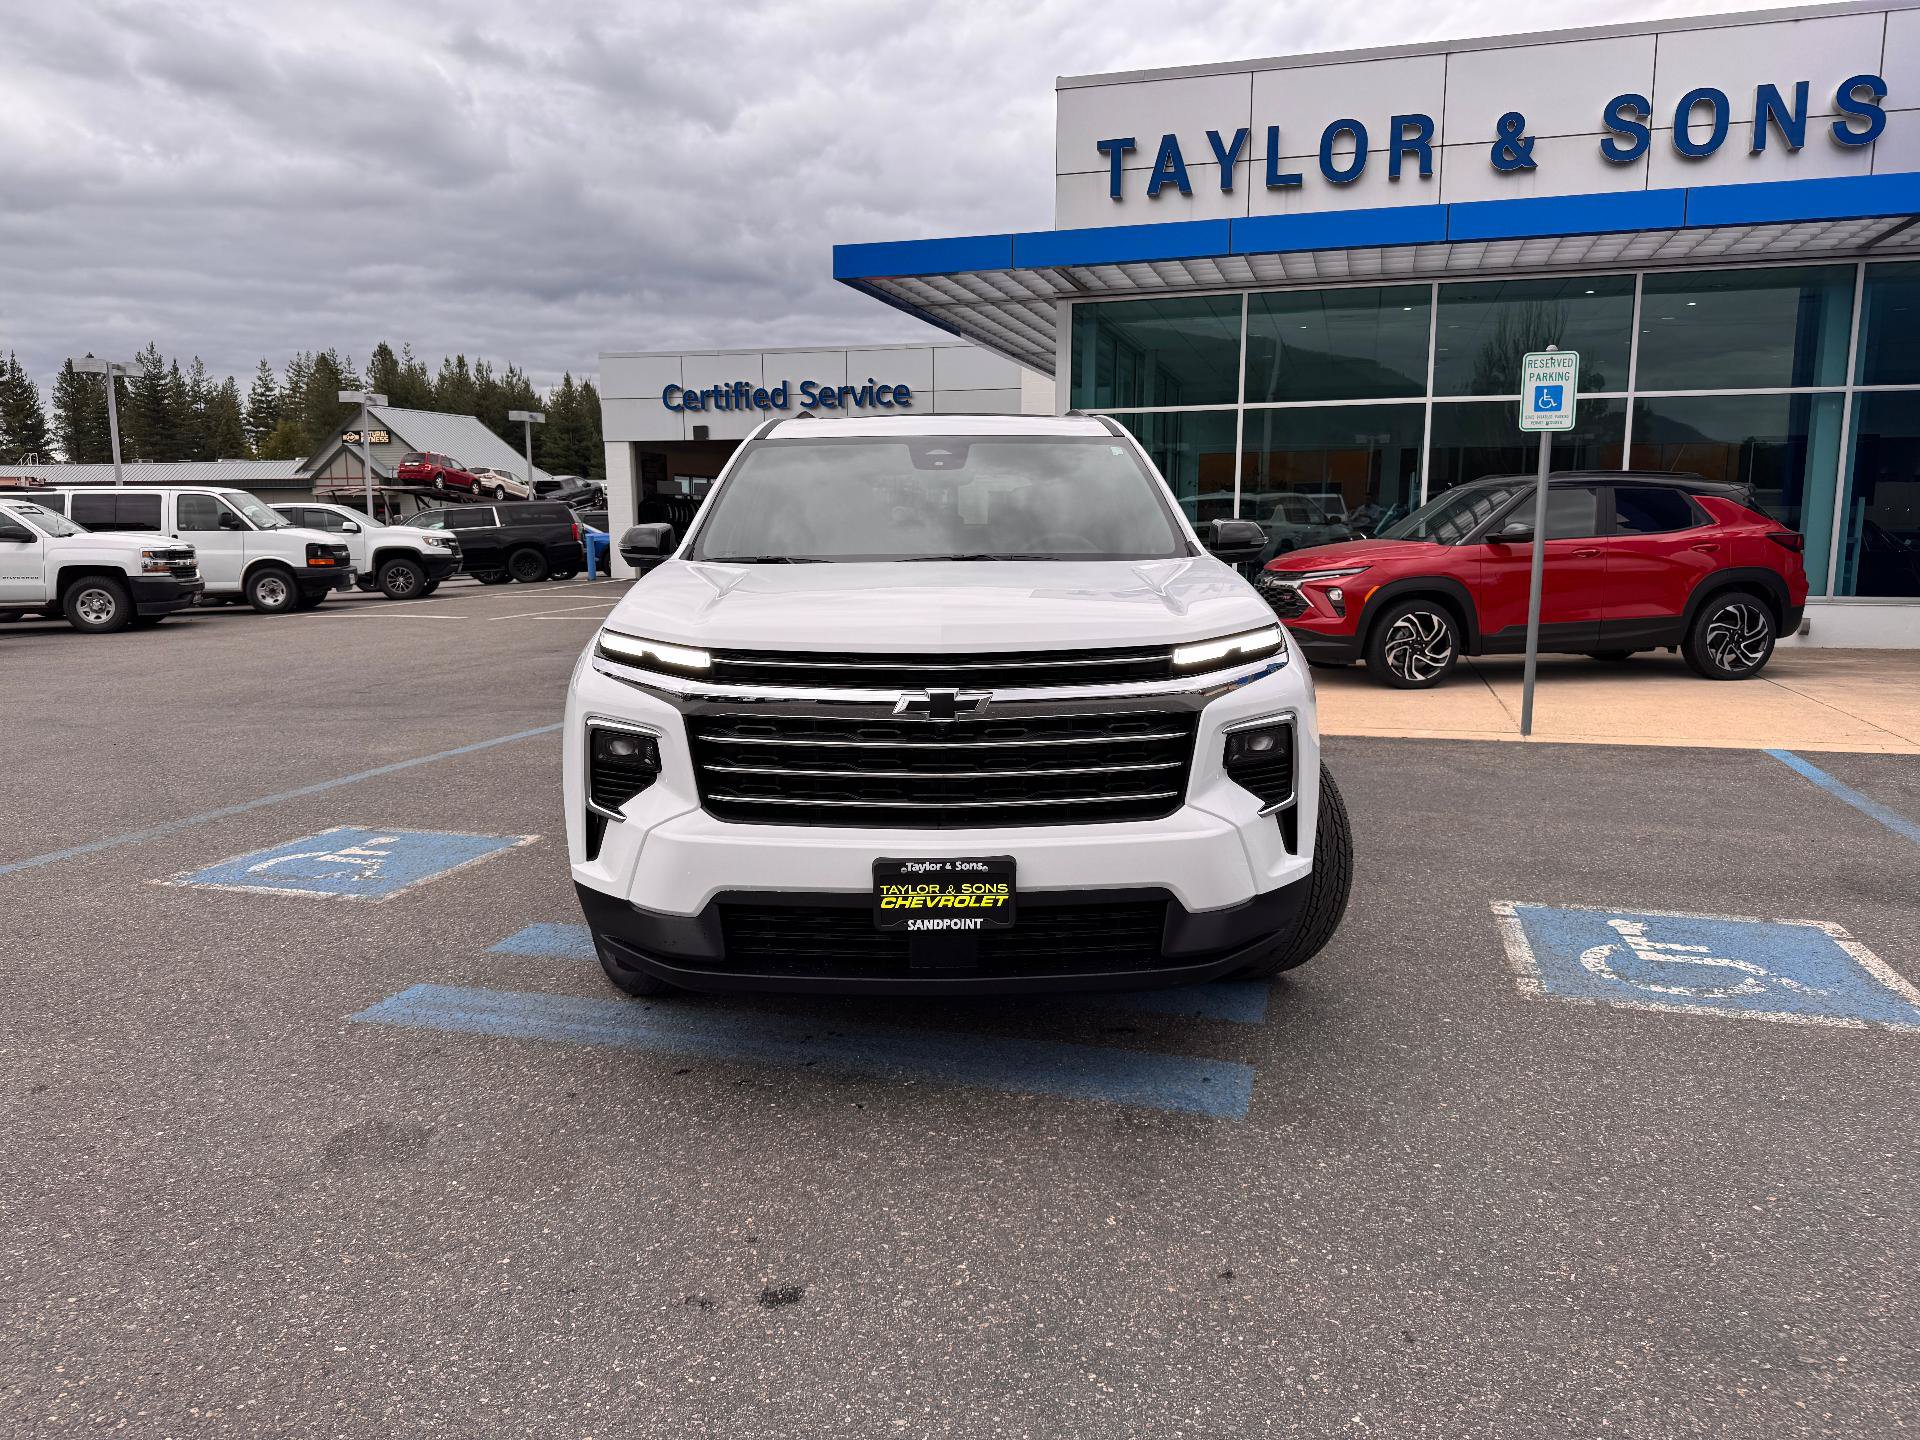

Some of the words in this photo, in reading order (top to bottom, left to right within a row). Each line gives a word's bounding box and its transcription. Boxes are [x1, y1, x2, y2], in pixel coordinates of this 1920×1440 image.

[1096, 113, 1435, 200] TAYLOR
[1490, 111, 1537, 172] &
[1600, 74, 1888, 164] SONS
[1527, 358, 1574, 369] RESERVED
[1529, 371, 1570, 382] PARKING
[662, 380, 790, 412] Certified
[799, 377, 913, 408] Service
[906, 862, 942, 873] Taylor
[945, 862, 952, 870] &
[955, 861, 983, 871] Sons
[880, 884, 940, 895] TAYLOR
[946, 884, 956, 895] &
[961, 883, 1009, 894] SONS
[880, 895, 1009, 909] CHEVROLET
[907, 918, 984, 931] SANDPOINT
